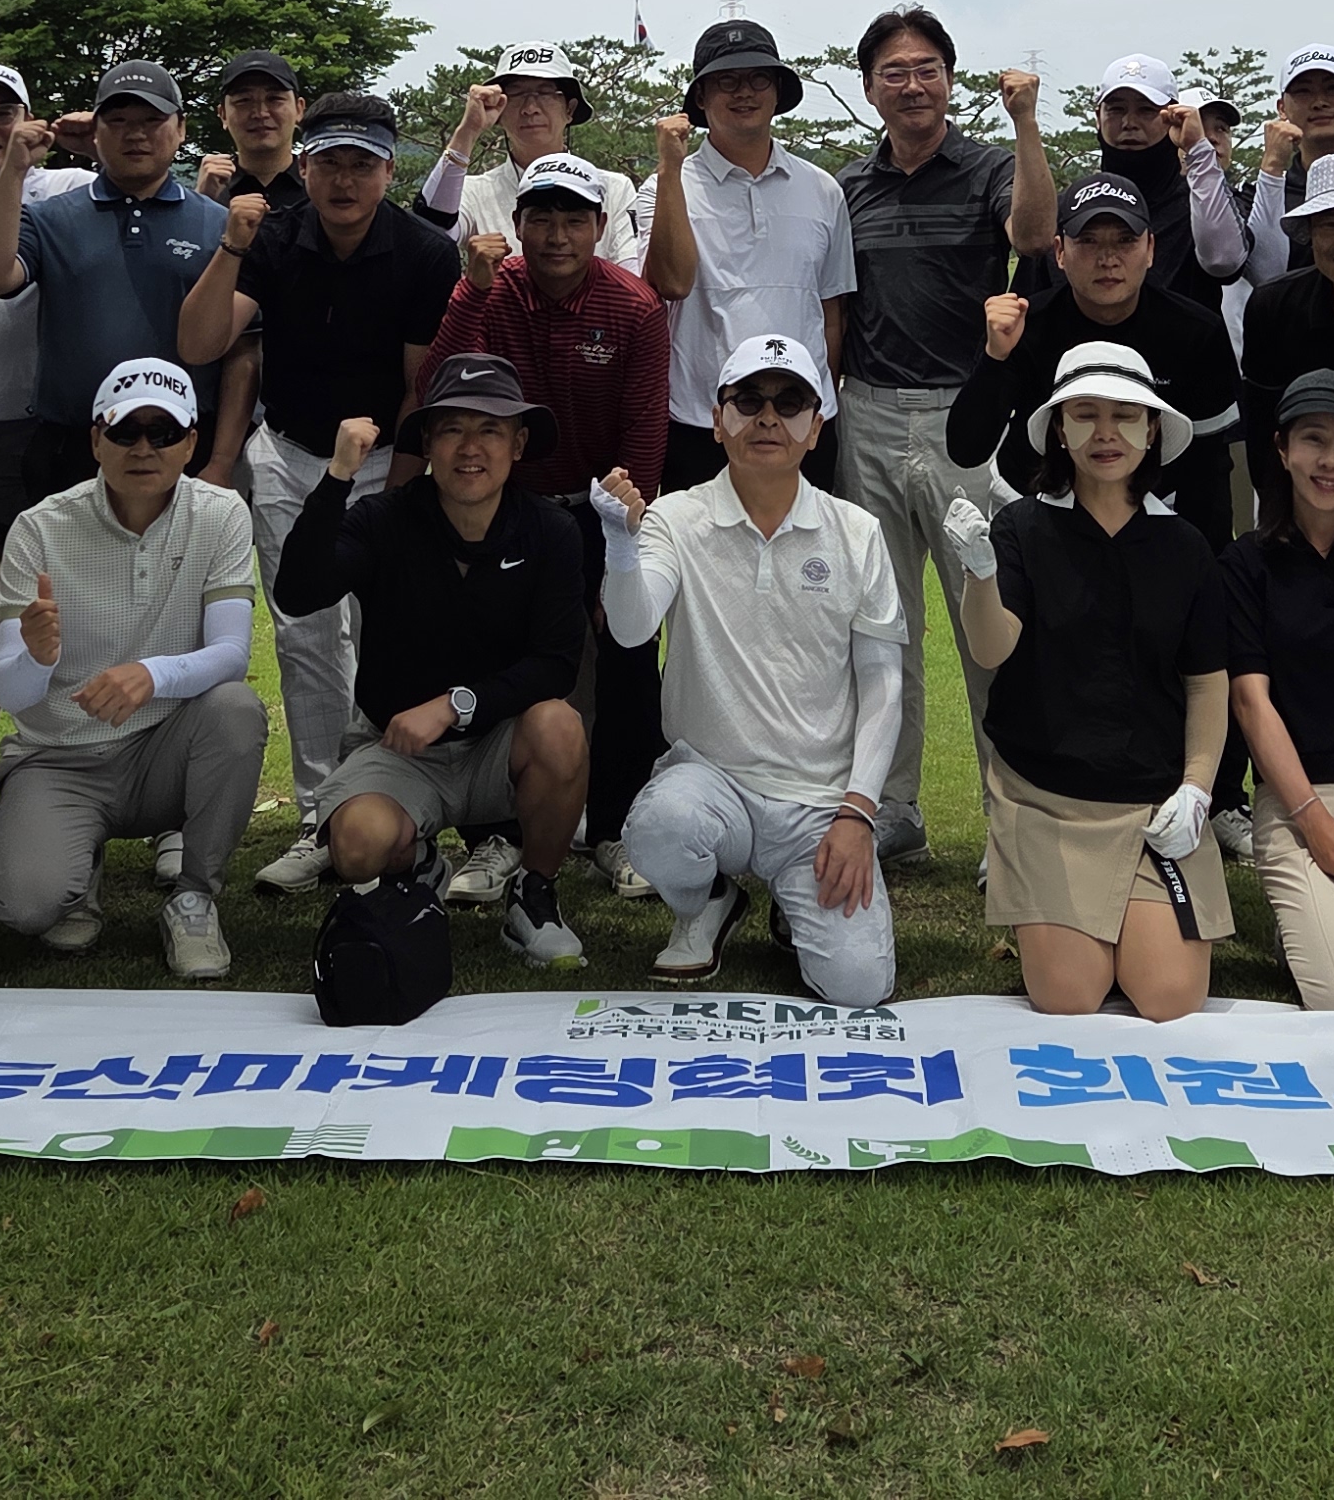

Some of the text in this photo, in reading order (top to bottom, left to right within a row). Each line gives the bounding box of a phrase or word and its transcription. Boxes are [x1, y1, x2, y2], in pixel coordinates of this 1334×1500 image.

[509, 48, 554, 71] BOB
[528, 160, 593, 182] Titleist
[1071, 180, 1138, 211] Titleist
[142, 371, 188, 400] YONEX
[574, 998, 899, 1024] KREMA
